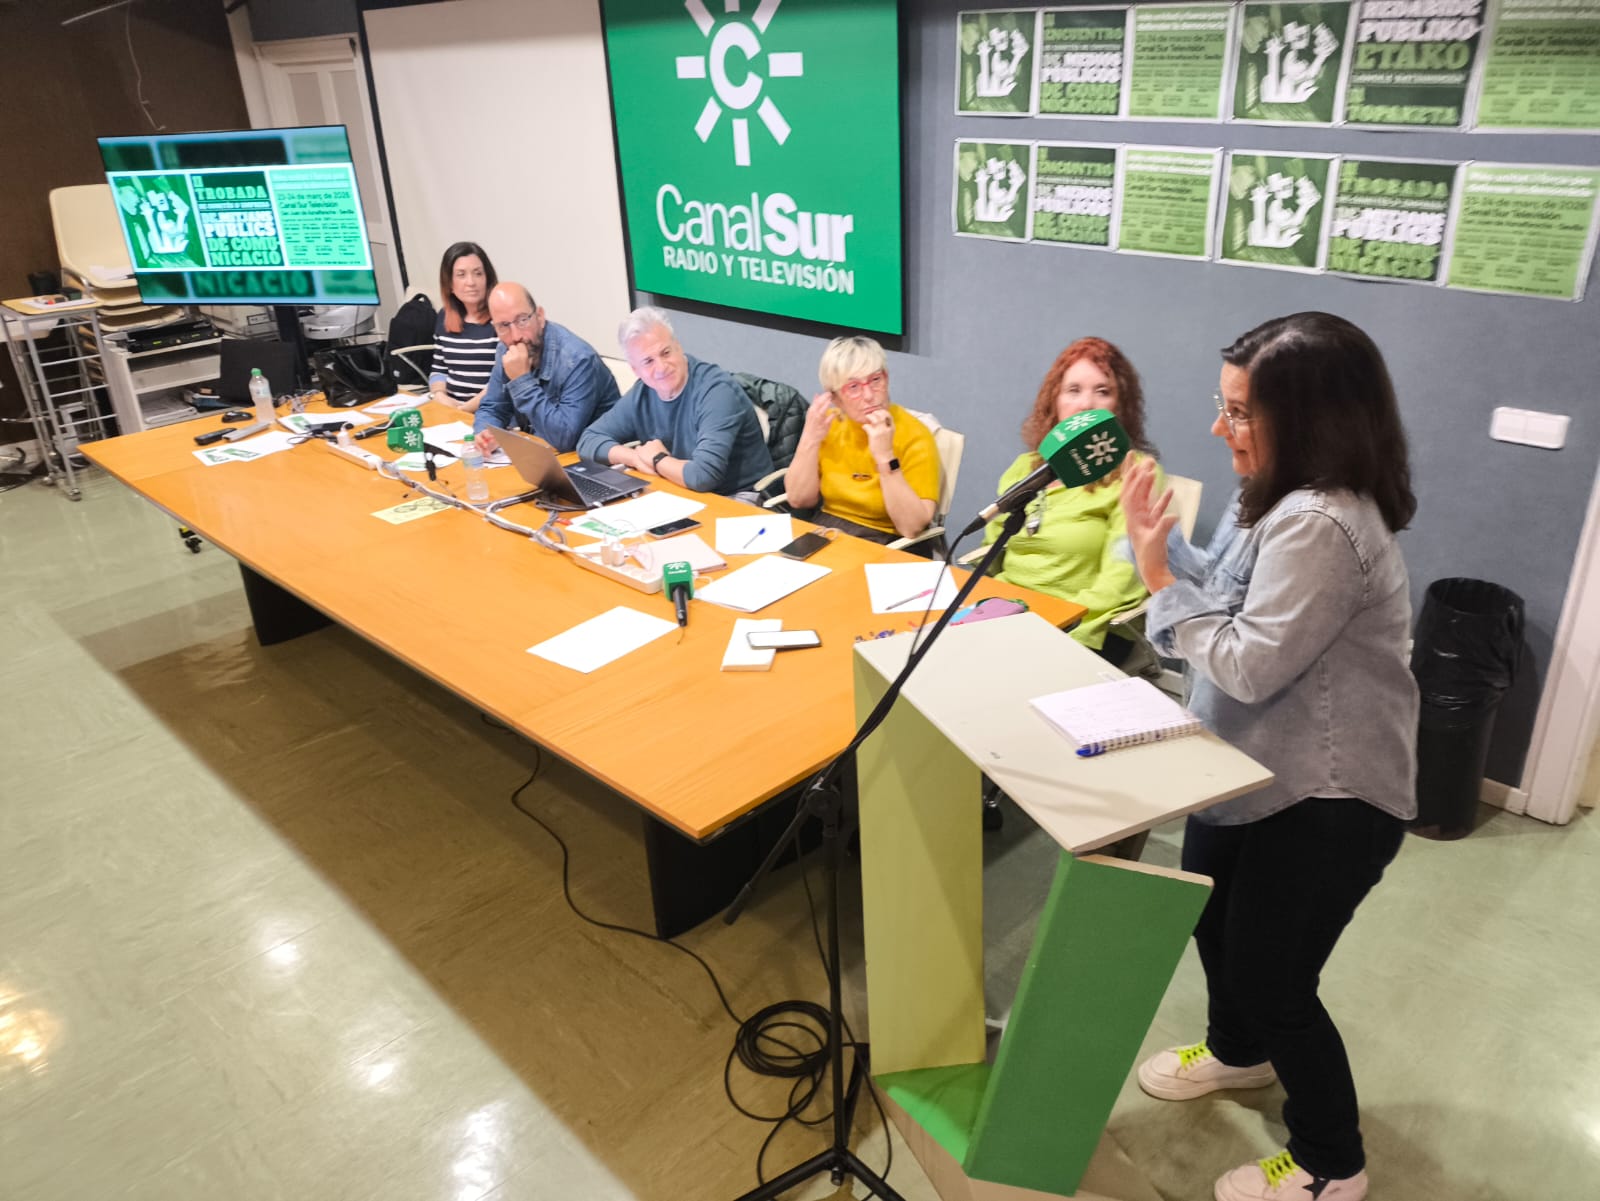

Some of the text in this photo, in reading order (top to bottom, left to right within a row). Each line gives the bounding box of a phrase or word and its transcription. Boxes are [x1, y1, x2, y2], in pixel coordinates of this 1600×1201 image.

[1354, 42, 1470, 70] ETAKO
[195, 185, 267, 200] TROBADA
[206, 238, 229, 252] DE
[662, 246, 854, 295] RADIO Y TELEVISIÓN
